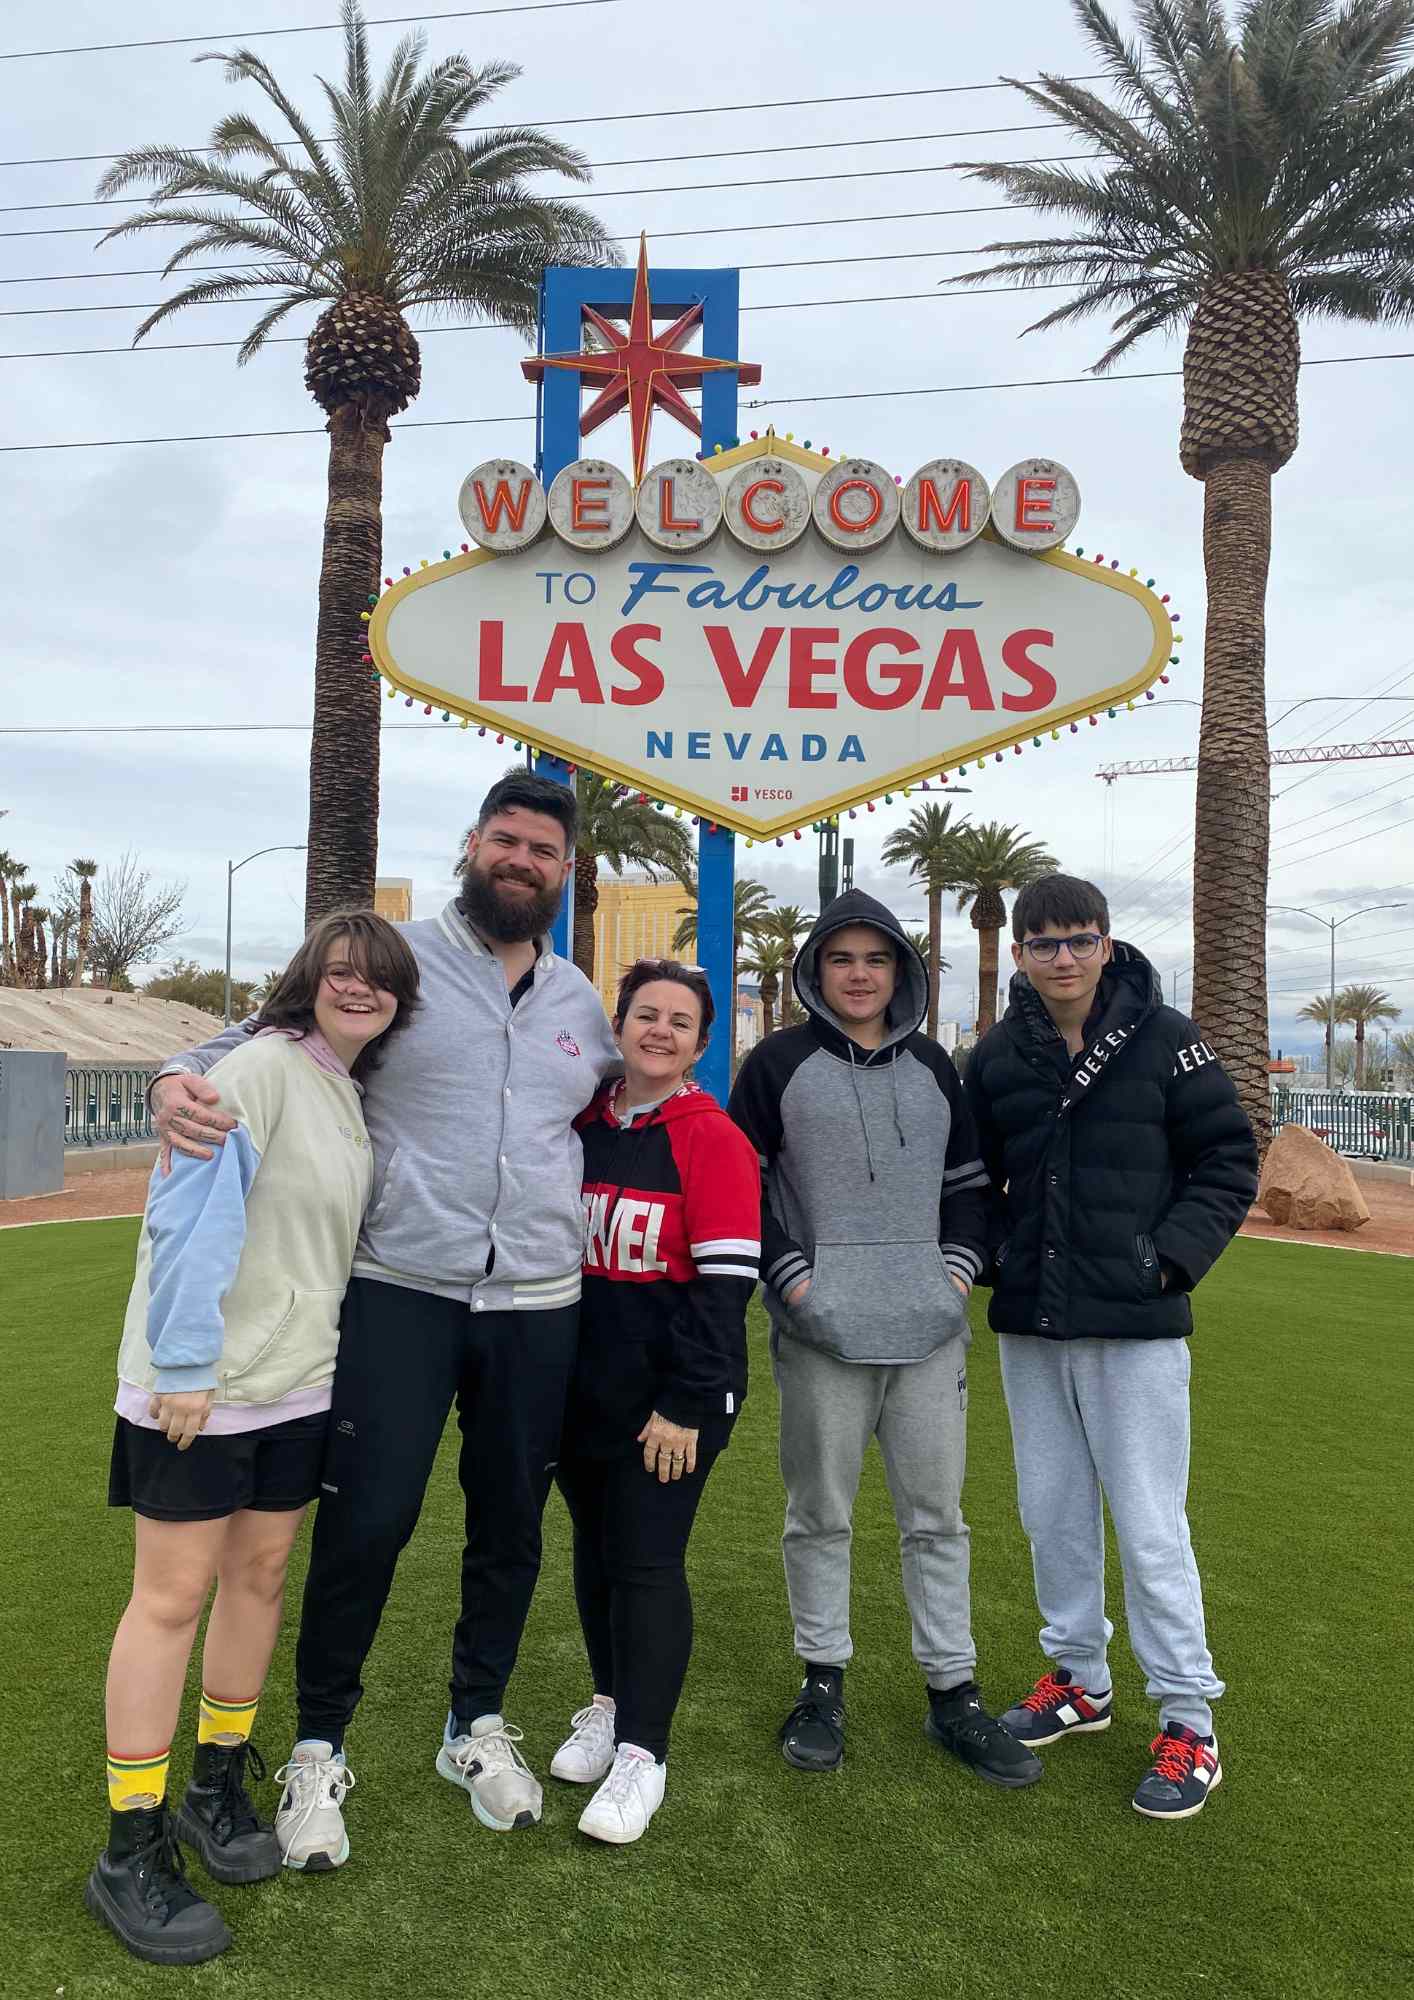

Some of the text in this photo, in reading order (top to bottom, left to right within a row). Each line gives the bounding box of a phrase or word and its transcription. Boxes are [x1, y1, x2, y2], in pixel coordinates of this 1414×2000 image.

[474, 478, 1058, 535] WELCOME
[537, 562, 984, 617] TO Fabulous
[478, 619, 1057, 713] LAS VEGAS
[645, 730, 866, 763] NEVADA
[754, 788, 793, 801] YESCO
